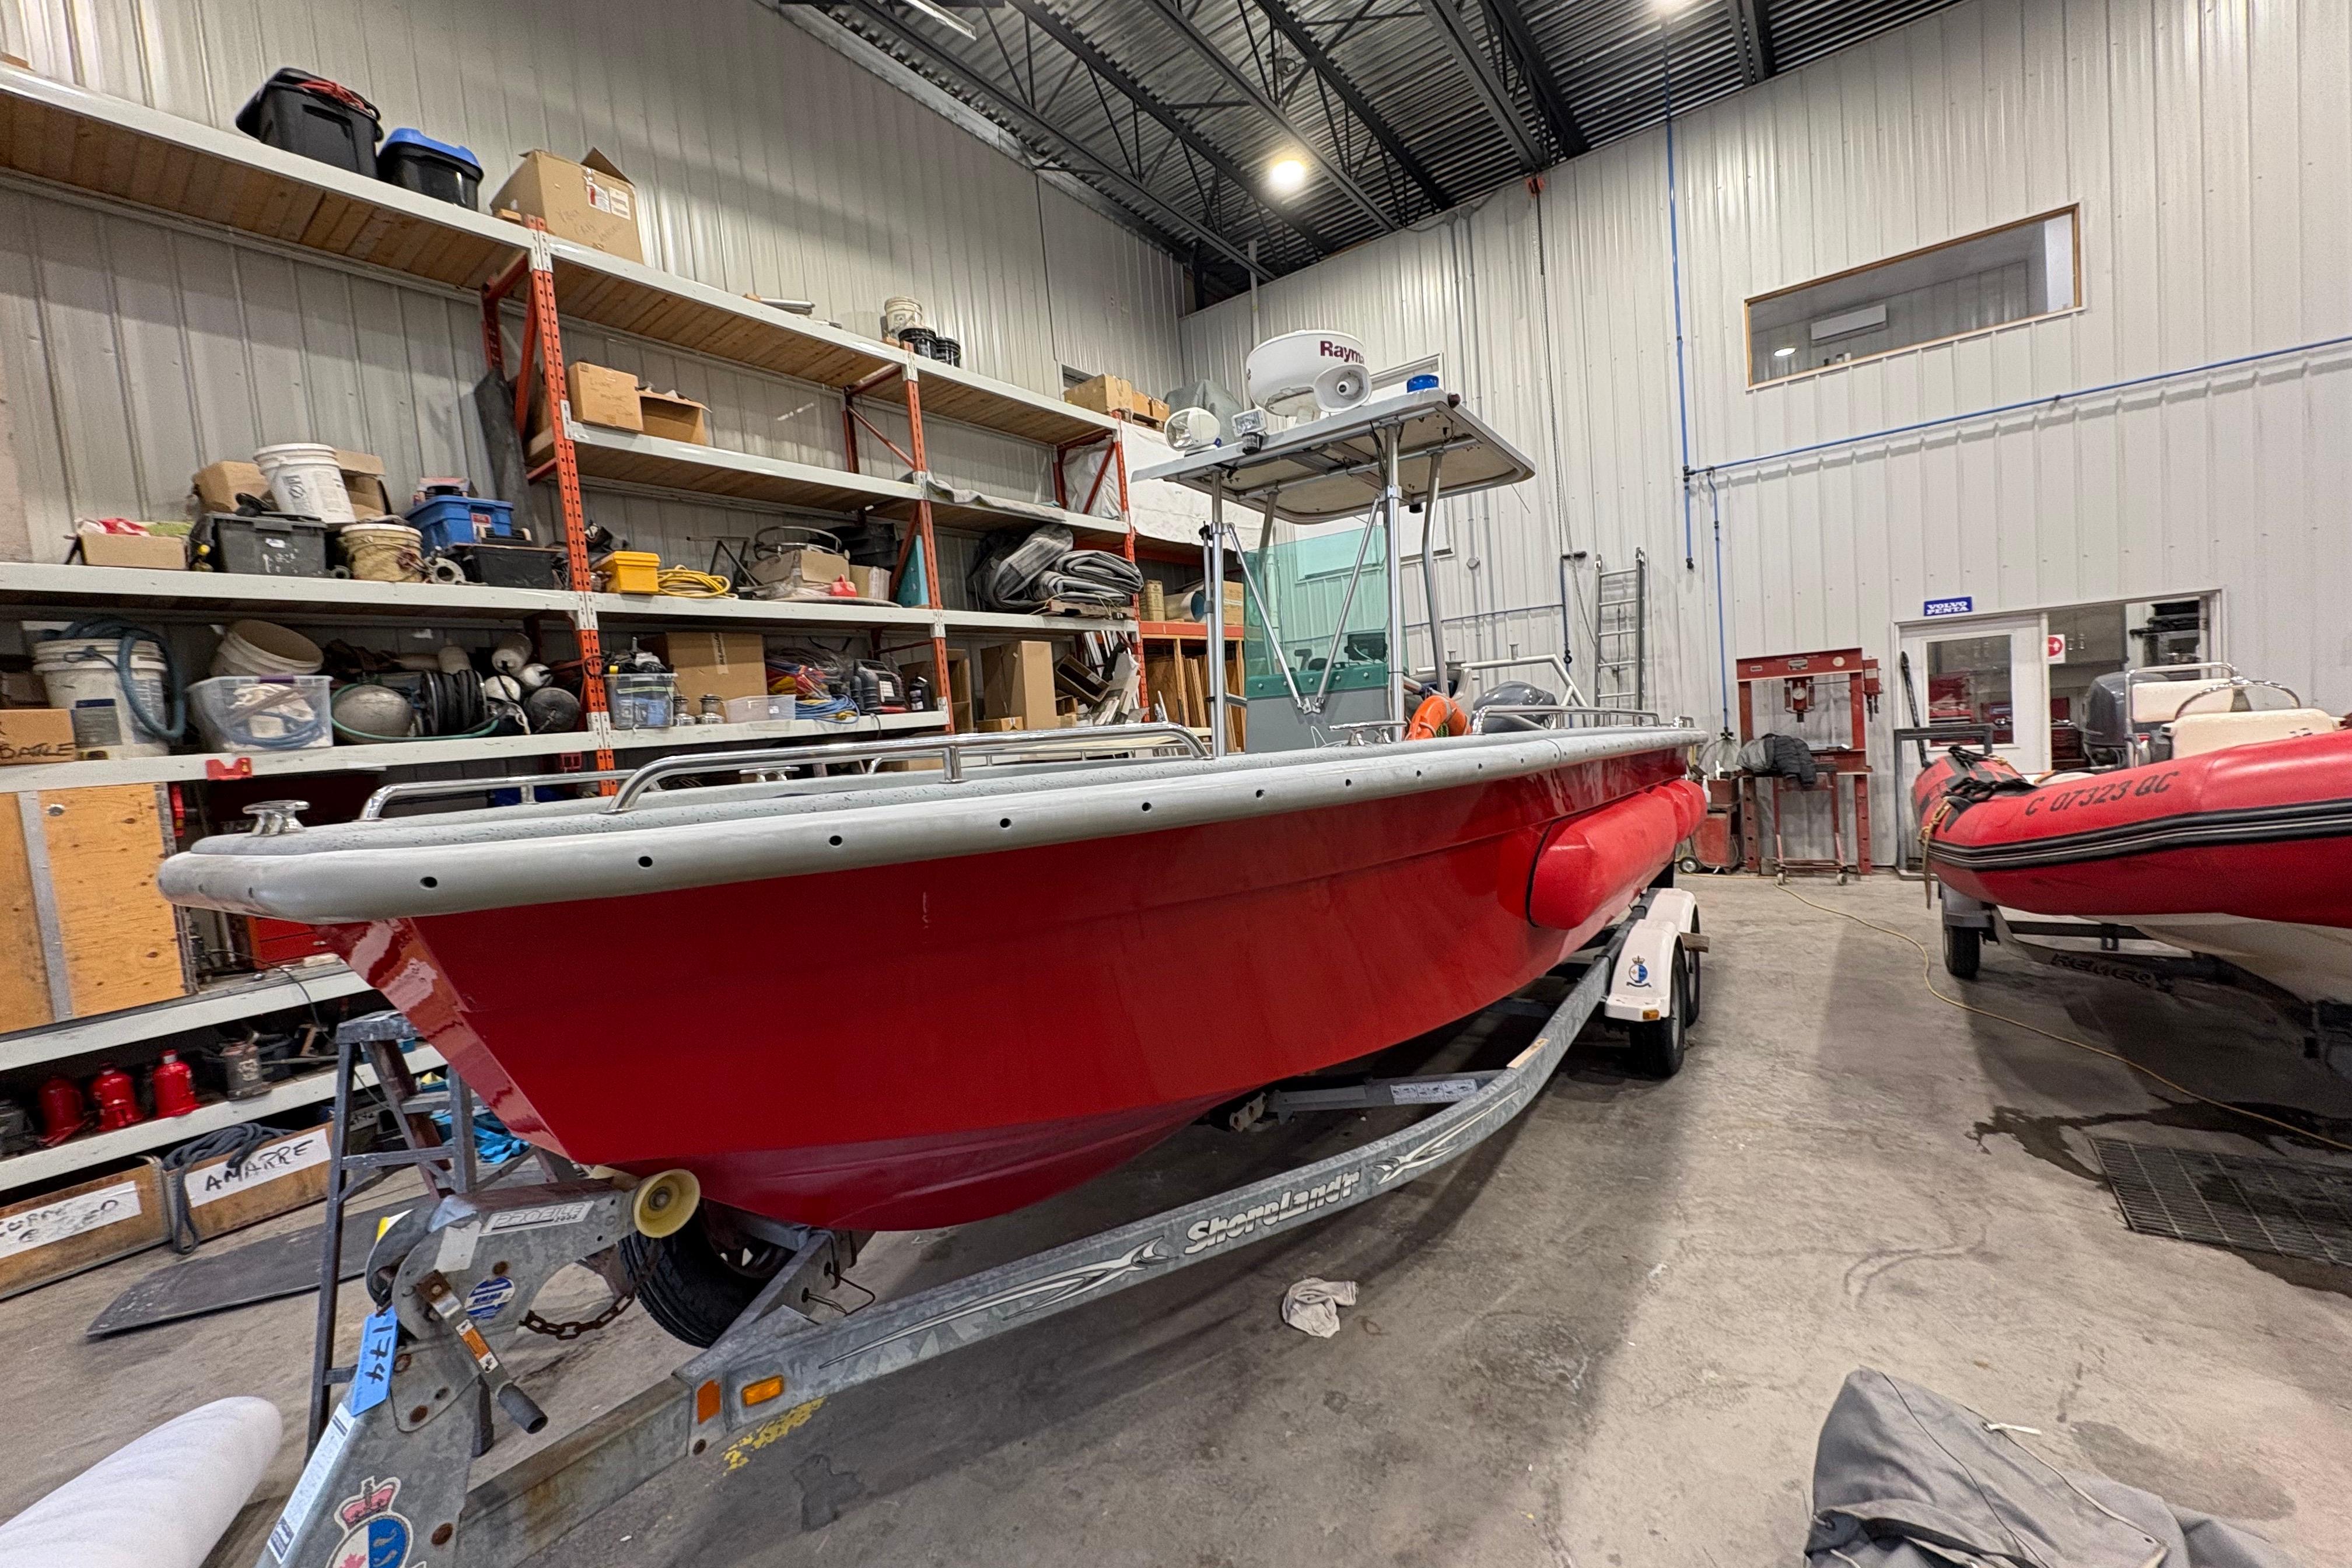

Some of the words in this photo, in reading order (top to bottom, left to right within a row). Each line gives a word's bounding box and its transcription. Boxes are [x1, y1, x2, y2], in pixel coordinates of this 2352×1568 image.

[1926, 607, 1969, 615] PENTA
[1927, 601, 1968, 610] VOLVO
[2025, 796, 2045, 816] C
[2050, 779, 2133, 812] 07323
[2134, 771, 2179, 796] QC
[364, 1325, 394, 1385] 174
